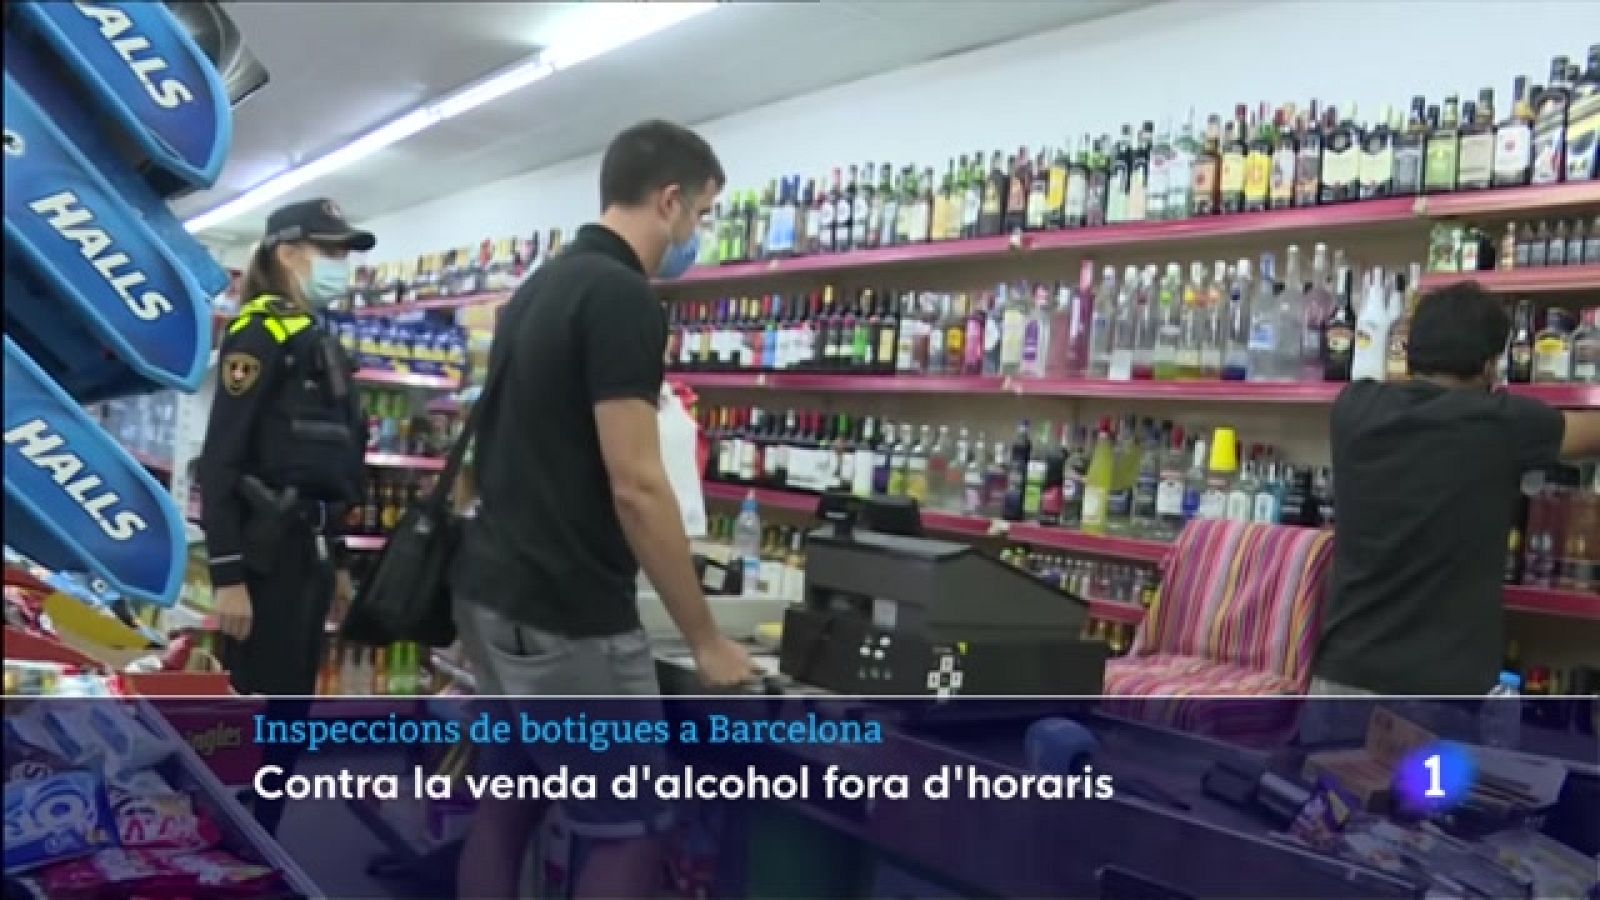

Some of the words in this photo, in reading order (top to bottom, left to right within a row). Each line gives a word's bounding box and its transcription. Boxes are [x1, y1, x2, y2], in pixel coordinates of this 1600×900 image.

[75, 2, 193, 108] ALLS
[29, 191, 174, 320] HALLS
[4, 418, 147, 541] HALLS
